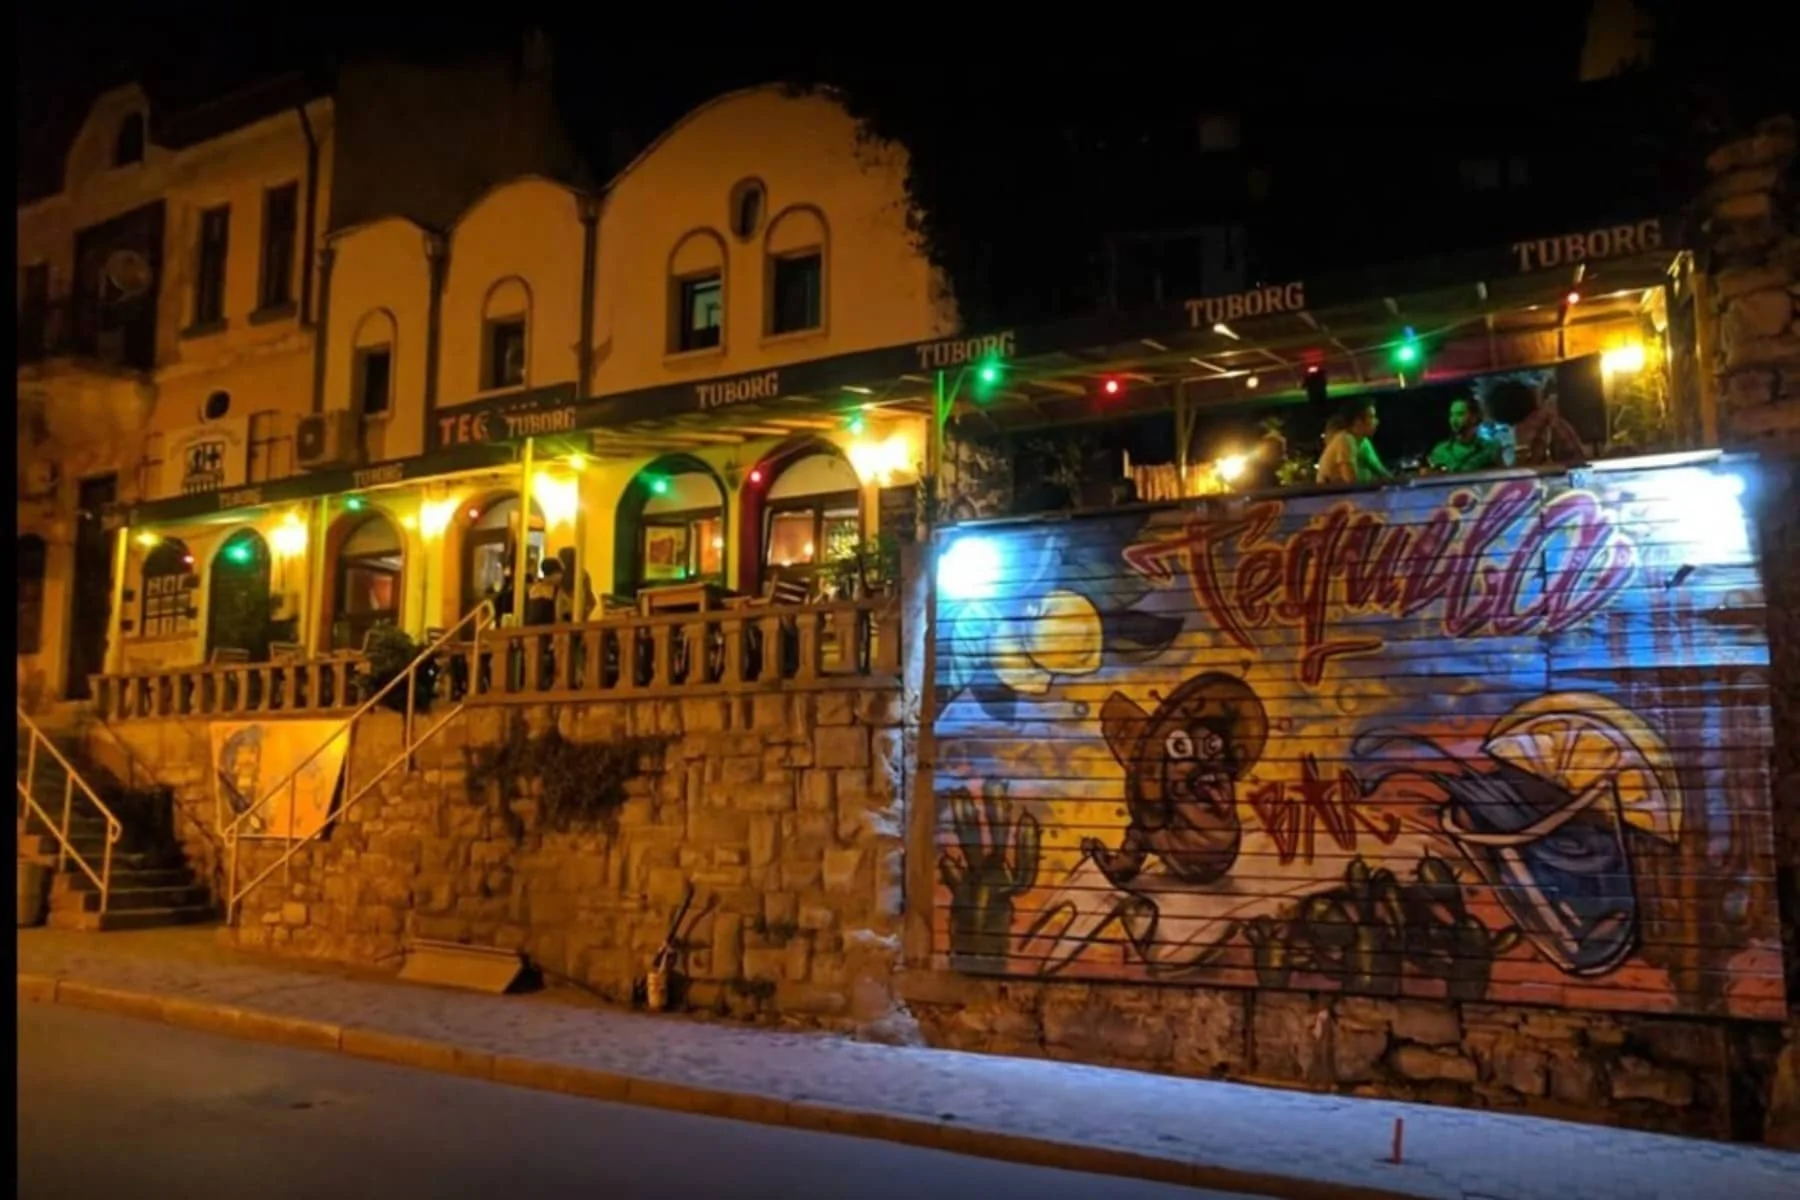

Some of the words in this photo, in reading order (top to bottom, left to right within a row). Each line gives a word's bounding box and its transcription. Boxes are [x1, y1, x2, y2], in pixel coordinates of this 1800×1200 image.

[1512, 219, 1661, 272] TUBORG
[1184, 281, 1304, 328] TUBORG
[916, 331, 1016, 369] TUBORG
[696, 373, 778, 408] TUBORG
[504, 406, 576, 438] TUBORG
